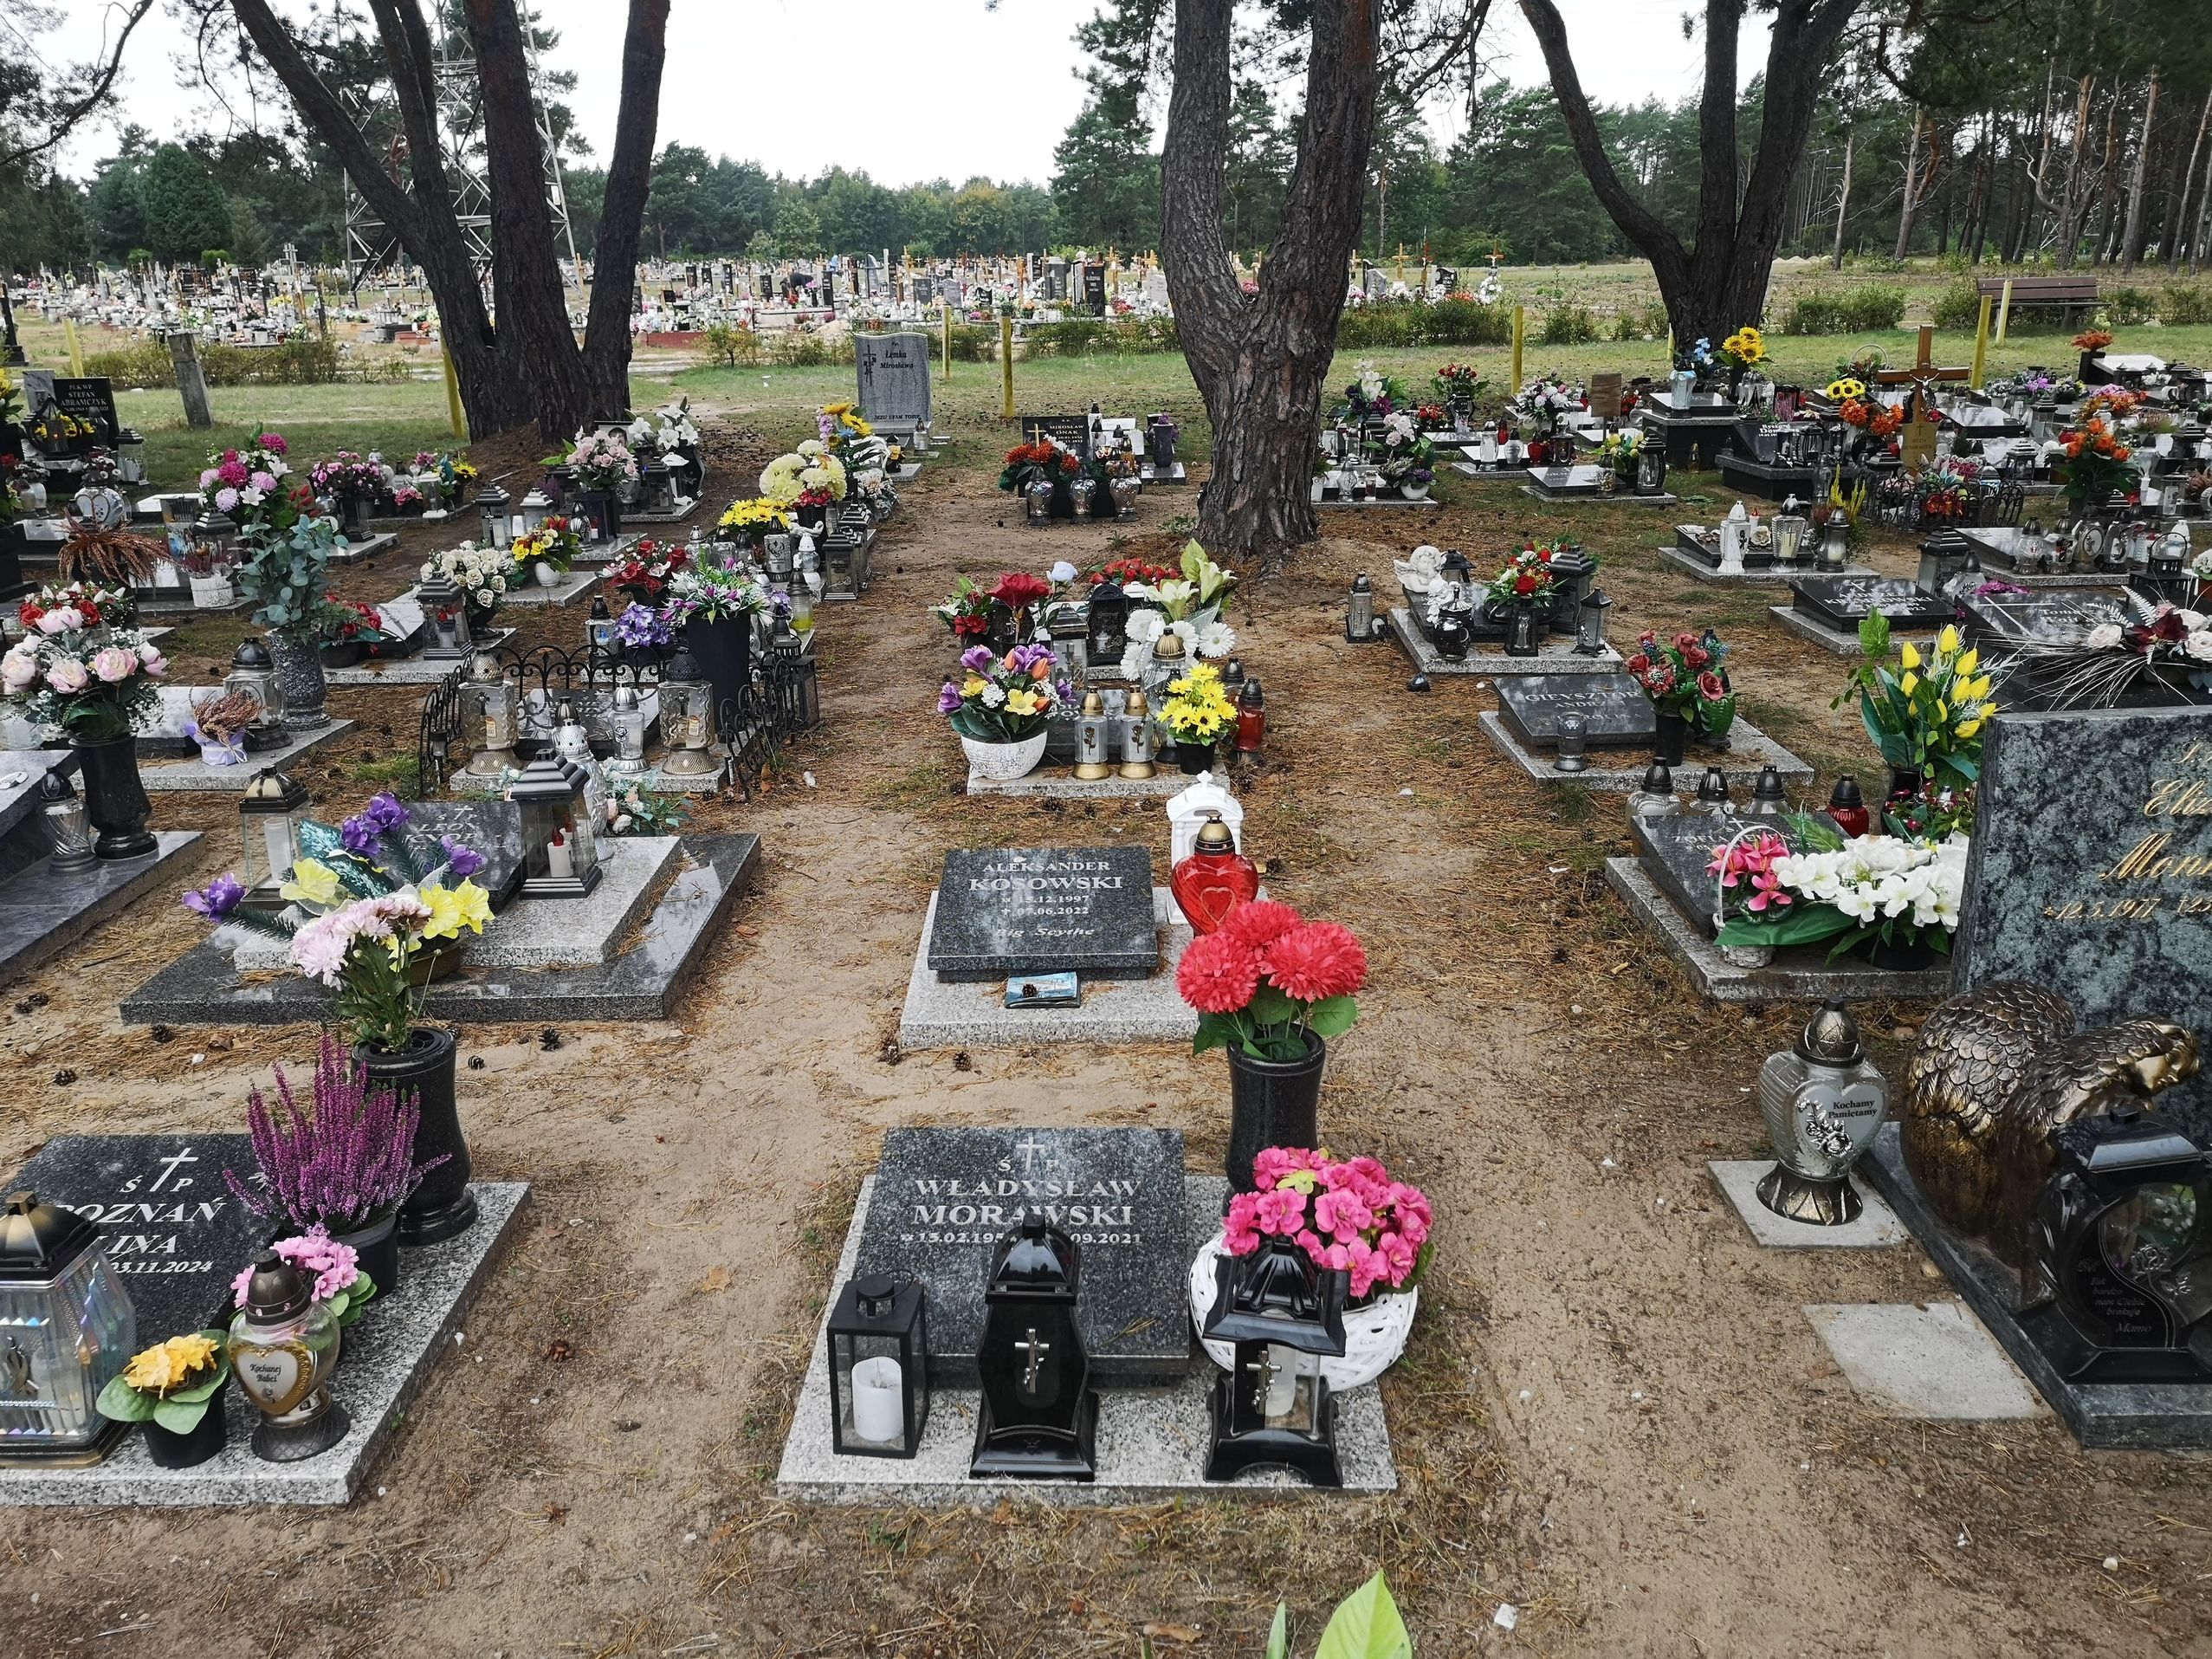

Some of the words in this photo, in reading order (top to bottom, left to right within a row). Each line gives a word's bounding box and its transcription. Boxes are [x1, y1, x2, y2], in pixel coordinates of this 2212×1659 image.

[417, 823, 481, 832] LEON
[982, 860, 1110, 873] ALEKSANDER
[969, 876, 1123, 891] KOSOWSKI
[1034, 927, 1096, 938] Scythe
[1833, 1099, 1875, 1110] Kochamy
[1828, 1109, 1878, 1119] Pamiętamy
[169, 1177, 194, 1193] P
[915, 1179, 1142, 1197] WŁADYSŁAW
[911, 1204, 1135, 1226] MORAWSKI
[2114, 1322, 2152, 1333] Mamo
